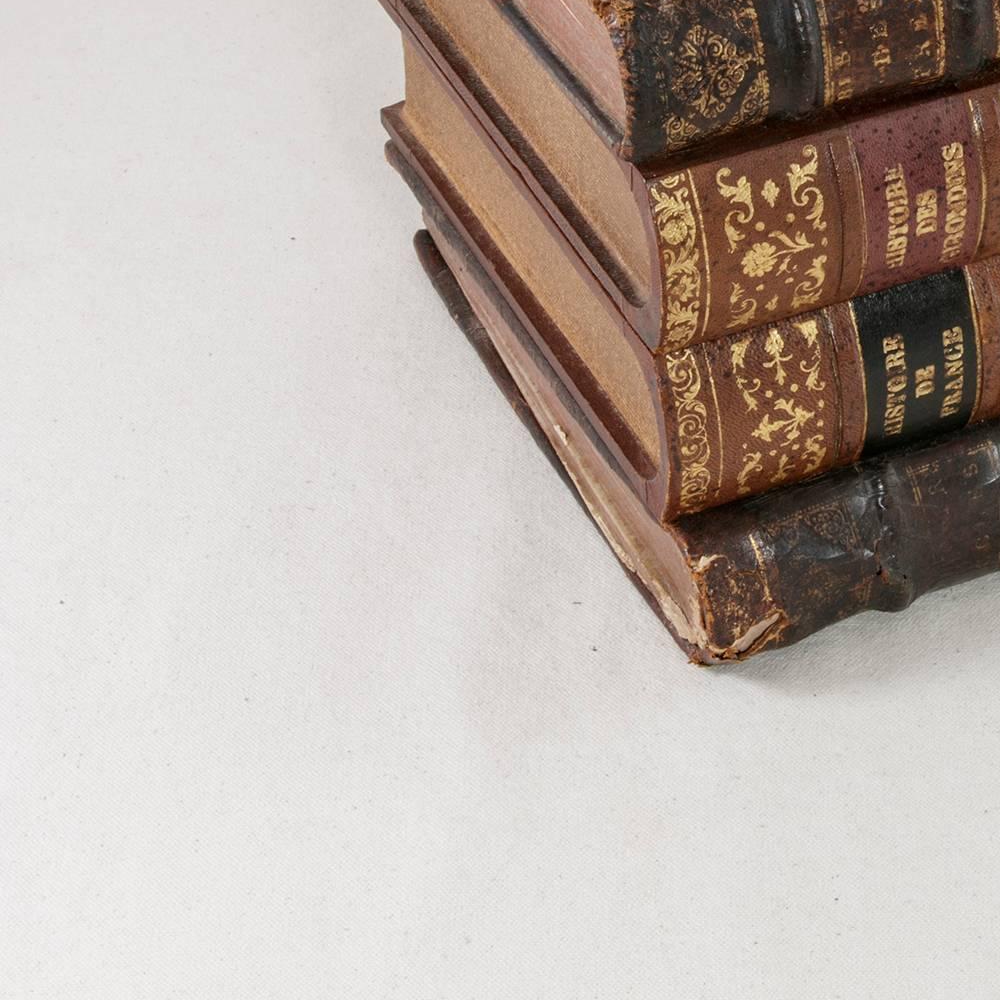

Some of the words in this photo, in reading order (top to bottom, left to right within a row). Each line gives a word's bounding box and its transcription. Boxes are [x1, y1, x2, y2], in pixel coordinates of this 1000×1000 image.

[916, 188, 938, 237] DES
[915, 364, 936, 398] DE
[940, 326, 964, 418] FRANCE
